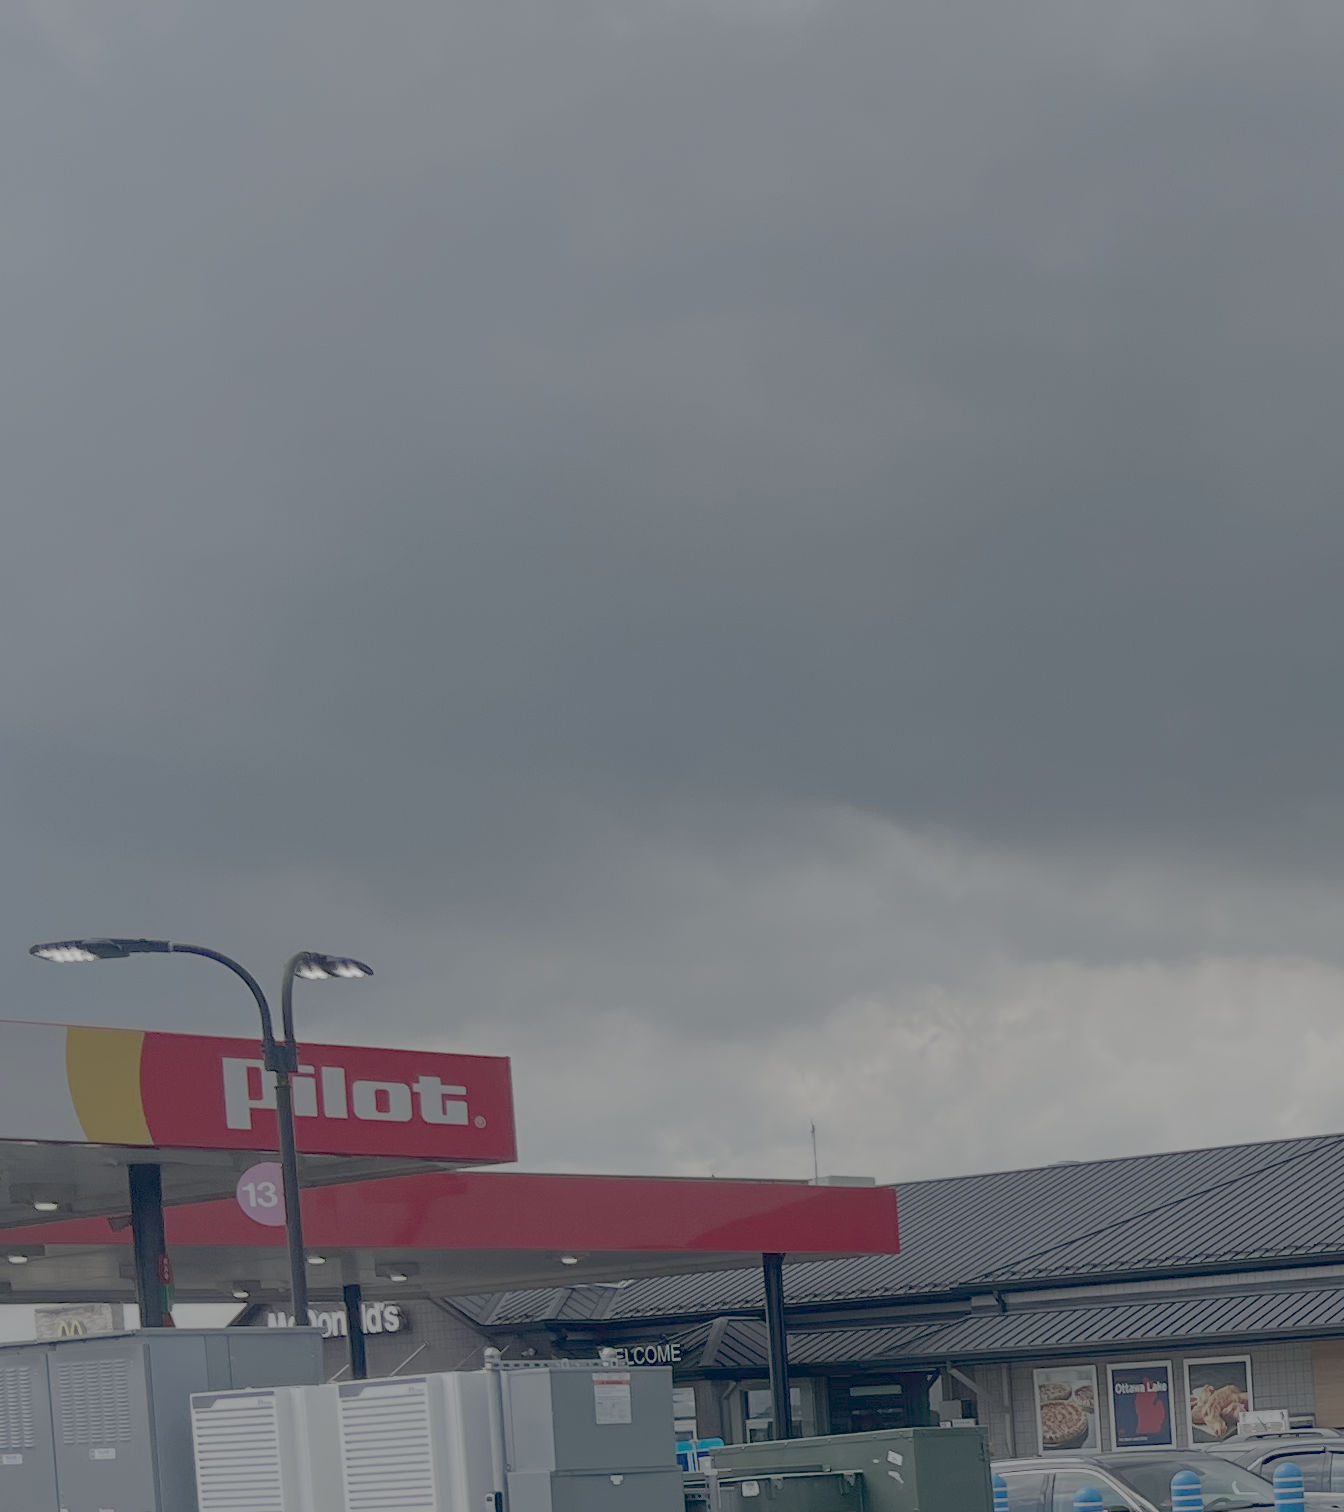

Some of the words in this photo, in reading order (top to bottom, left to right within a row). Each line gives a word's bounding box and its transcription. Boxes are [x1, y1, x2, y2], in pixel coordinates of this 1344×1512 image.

[241, 1181, 279, 1208] 13
[600, 1343, 682, 1365] ELCOME
[1115, 1382, 1145, 1395] Ottawa
[1146, 1381, 1167, 1393] Lake
